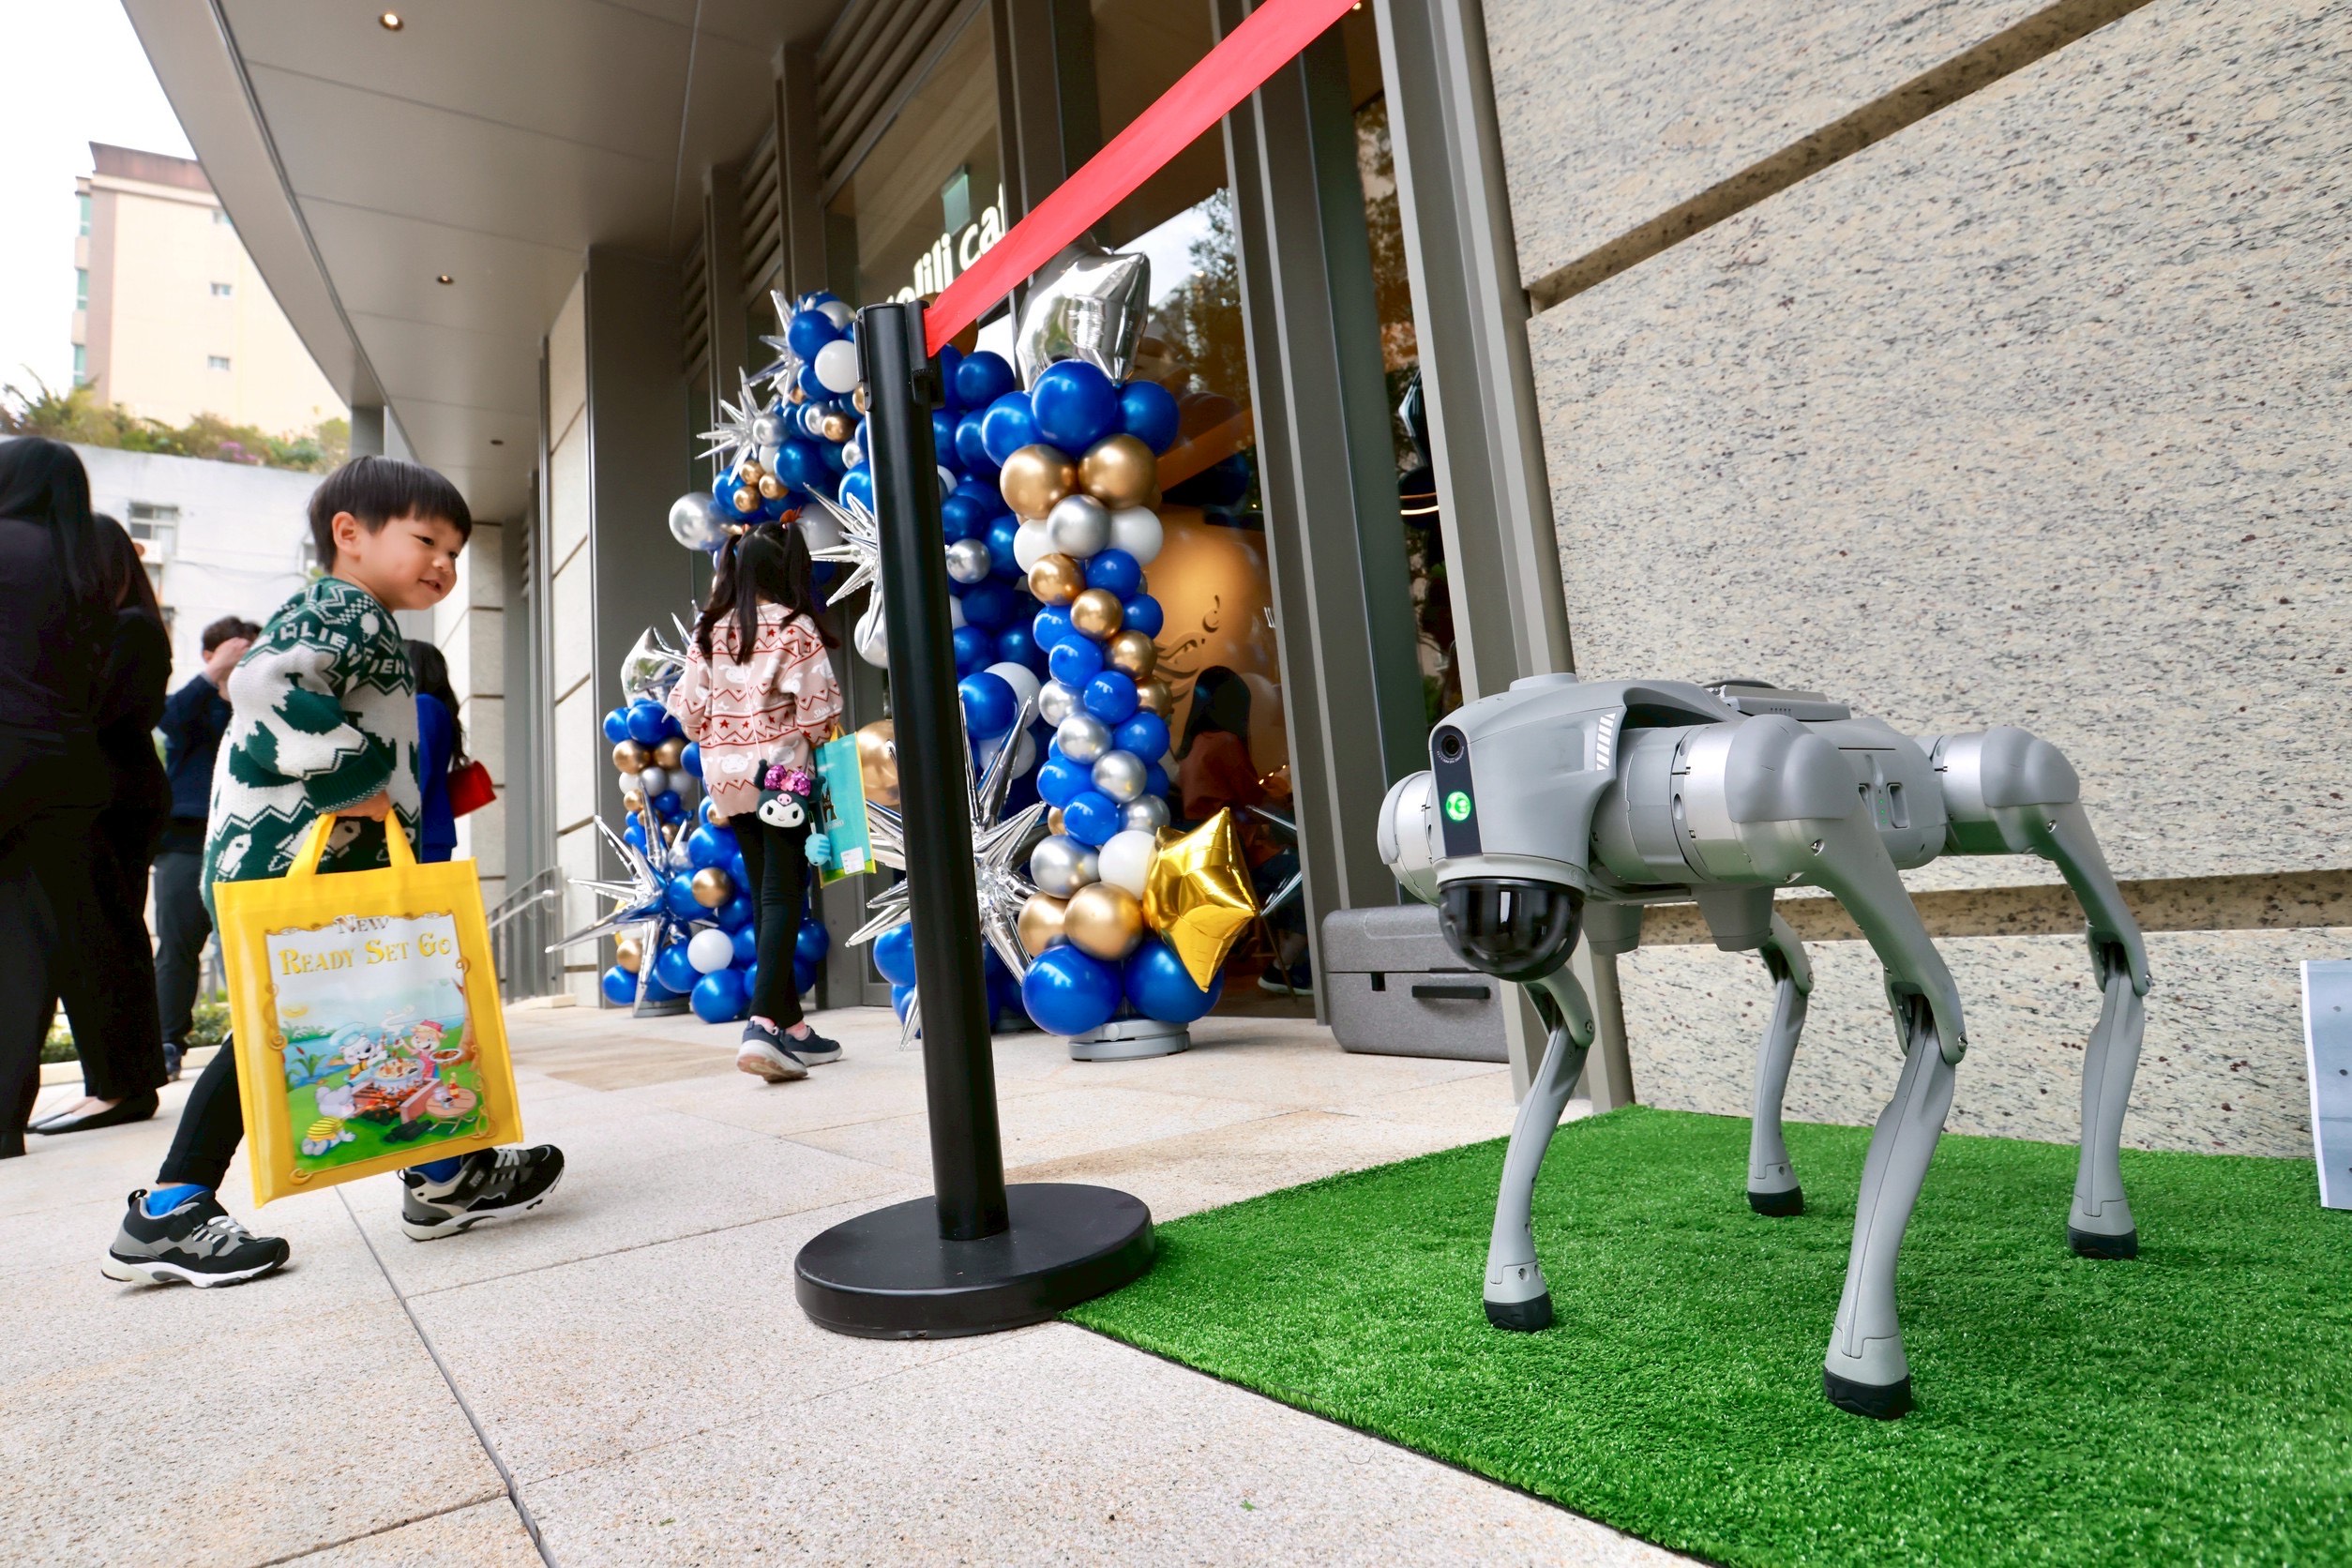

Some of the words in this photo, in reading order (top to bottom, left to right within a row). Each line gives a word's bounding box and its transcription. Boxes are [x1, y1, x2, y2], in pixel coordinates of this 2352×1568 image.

[336, 914, 389, 935] NEW
[278, 948, 354, 976] READY
[365, 940, 410, 965] SET
[418, 932, 452, 957] GO
